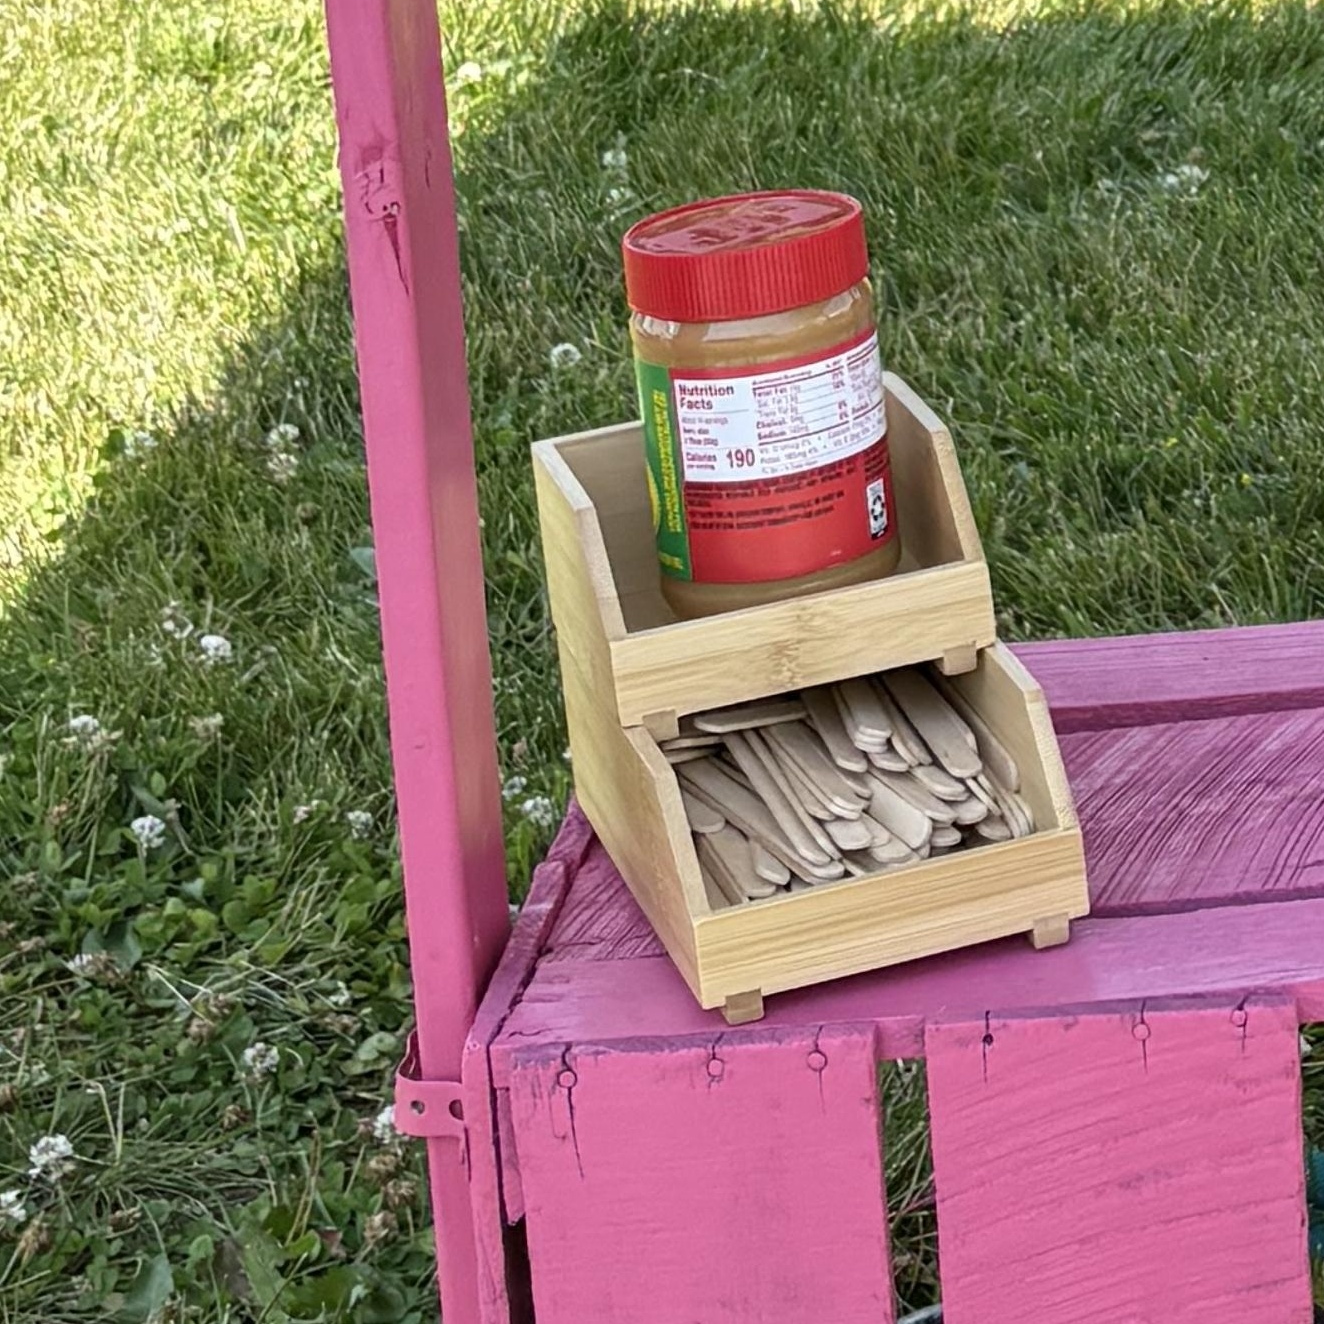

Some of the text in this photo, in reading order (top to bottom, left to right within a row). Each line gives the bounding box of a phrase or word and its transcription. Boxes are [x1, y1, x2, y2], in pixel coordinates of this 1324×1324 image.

[678, 383, 735, 397] Nutrition
[680, 397, 714, 410] Facts
[726, 448, 755, 469] 190
